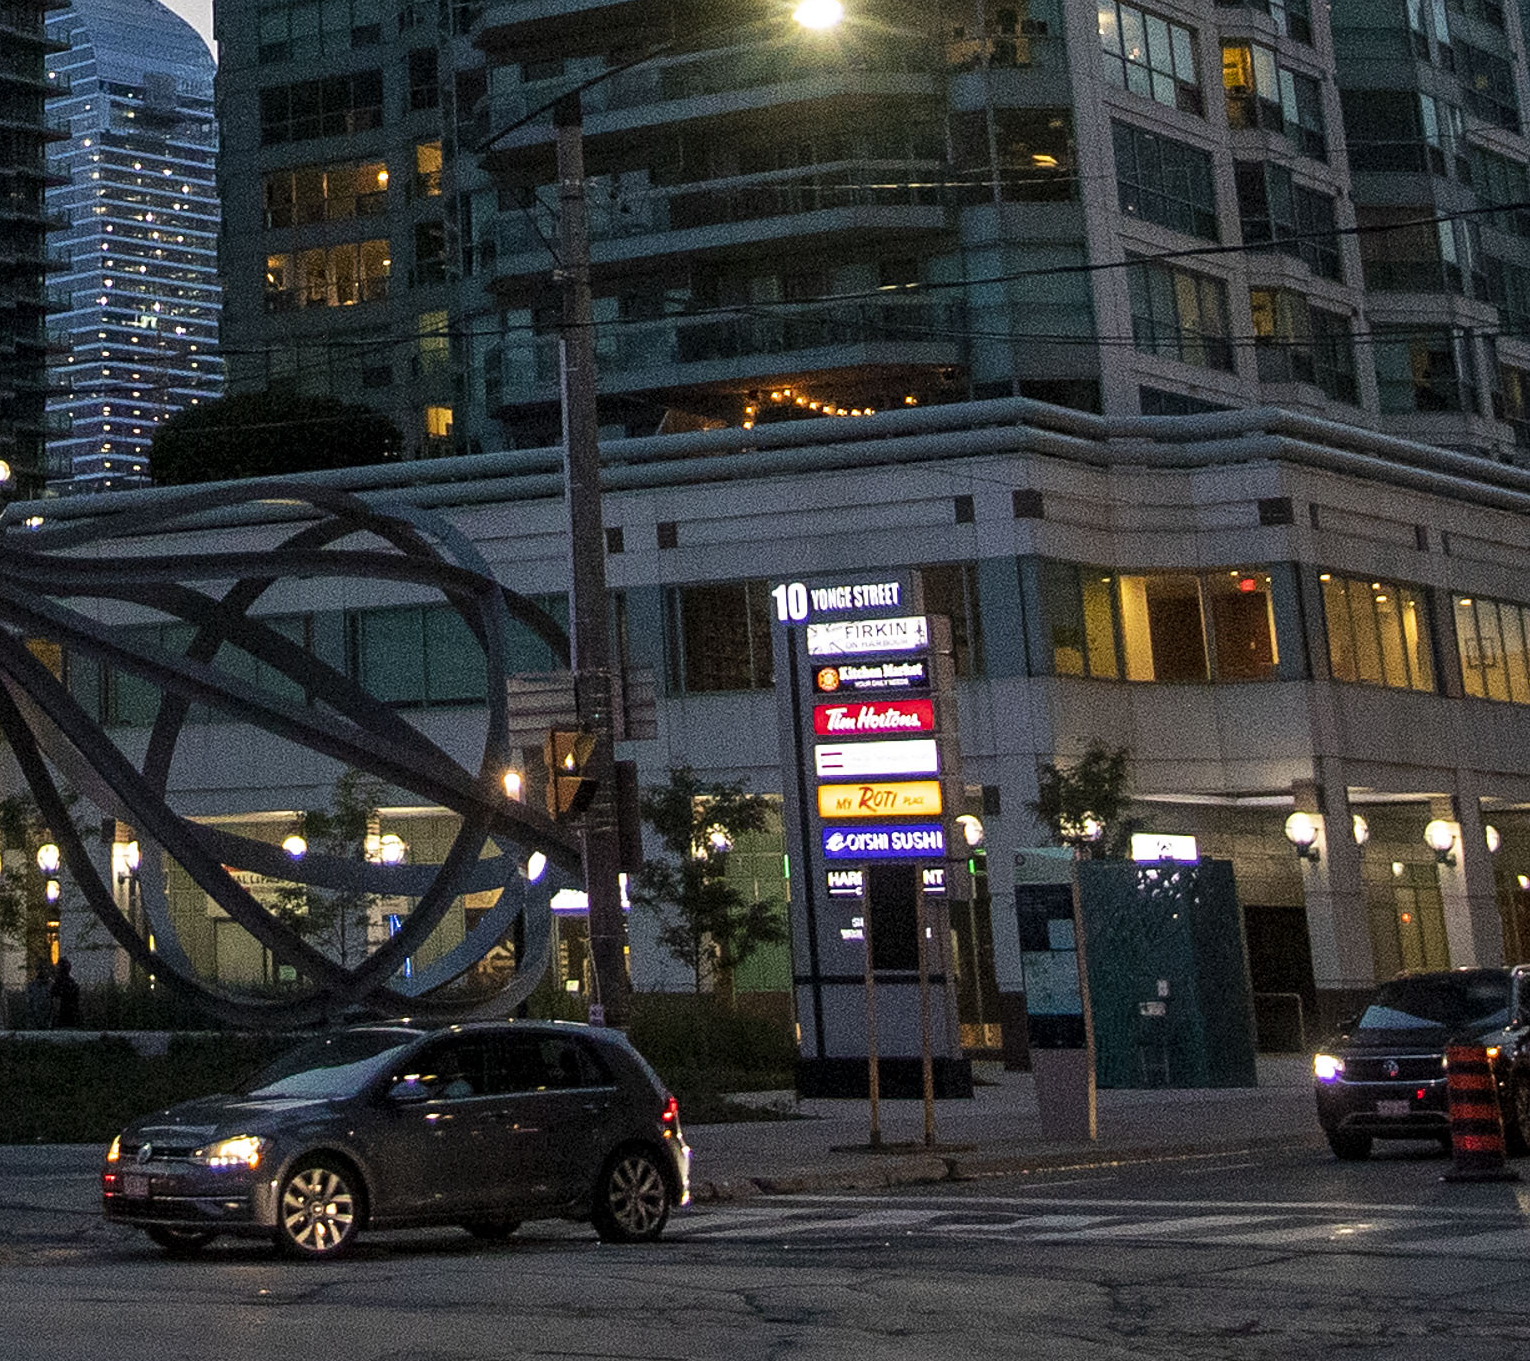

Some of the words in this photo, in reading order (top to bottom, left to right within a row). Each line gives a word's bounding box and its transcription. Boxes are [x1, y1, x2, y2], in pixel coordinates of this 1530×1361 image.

[772, 582, 808, 621] 10
[811, 587, 852, 611] YONGE
[853, 582, 900, 607] STREET
[845, 621, 907, 639] FIRKIN
[845, 640, 859, 649] ON
[861, 638, 909, 648] HARBOUR
[839, 664, 883, 681] Kitchen
[883, 662, 923, 678] Market
[825, 707, 856, 731] Tim
[836, 797, 852, 810] MY
[858, 786, 898, 813] ROTI
[891, 831, 944, 850] SUSHI
